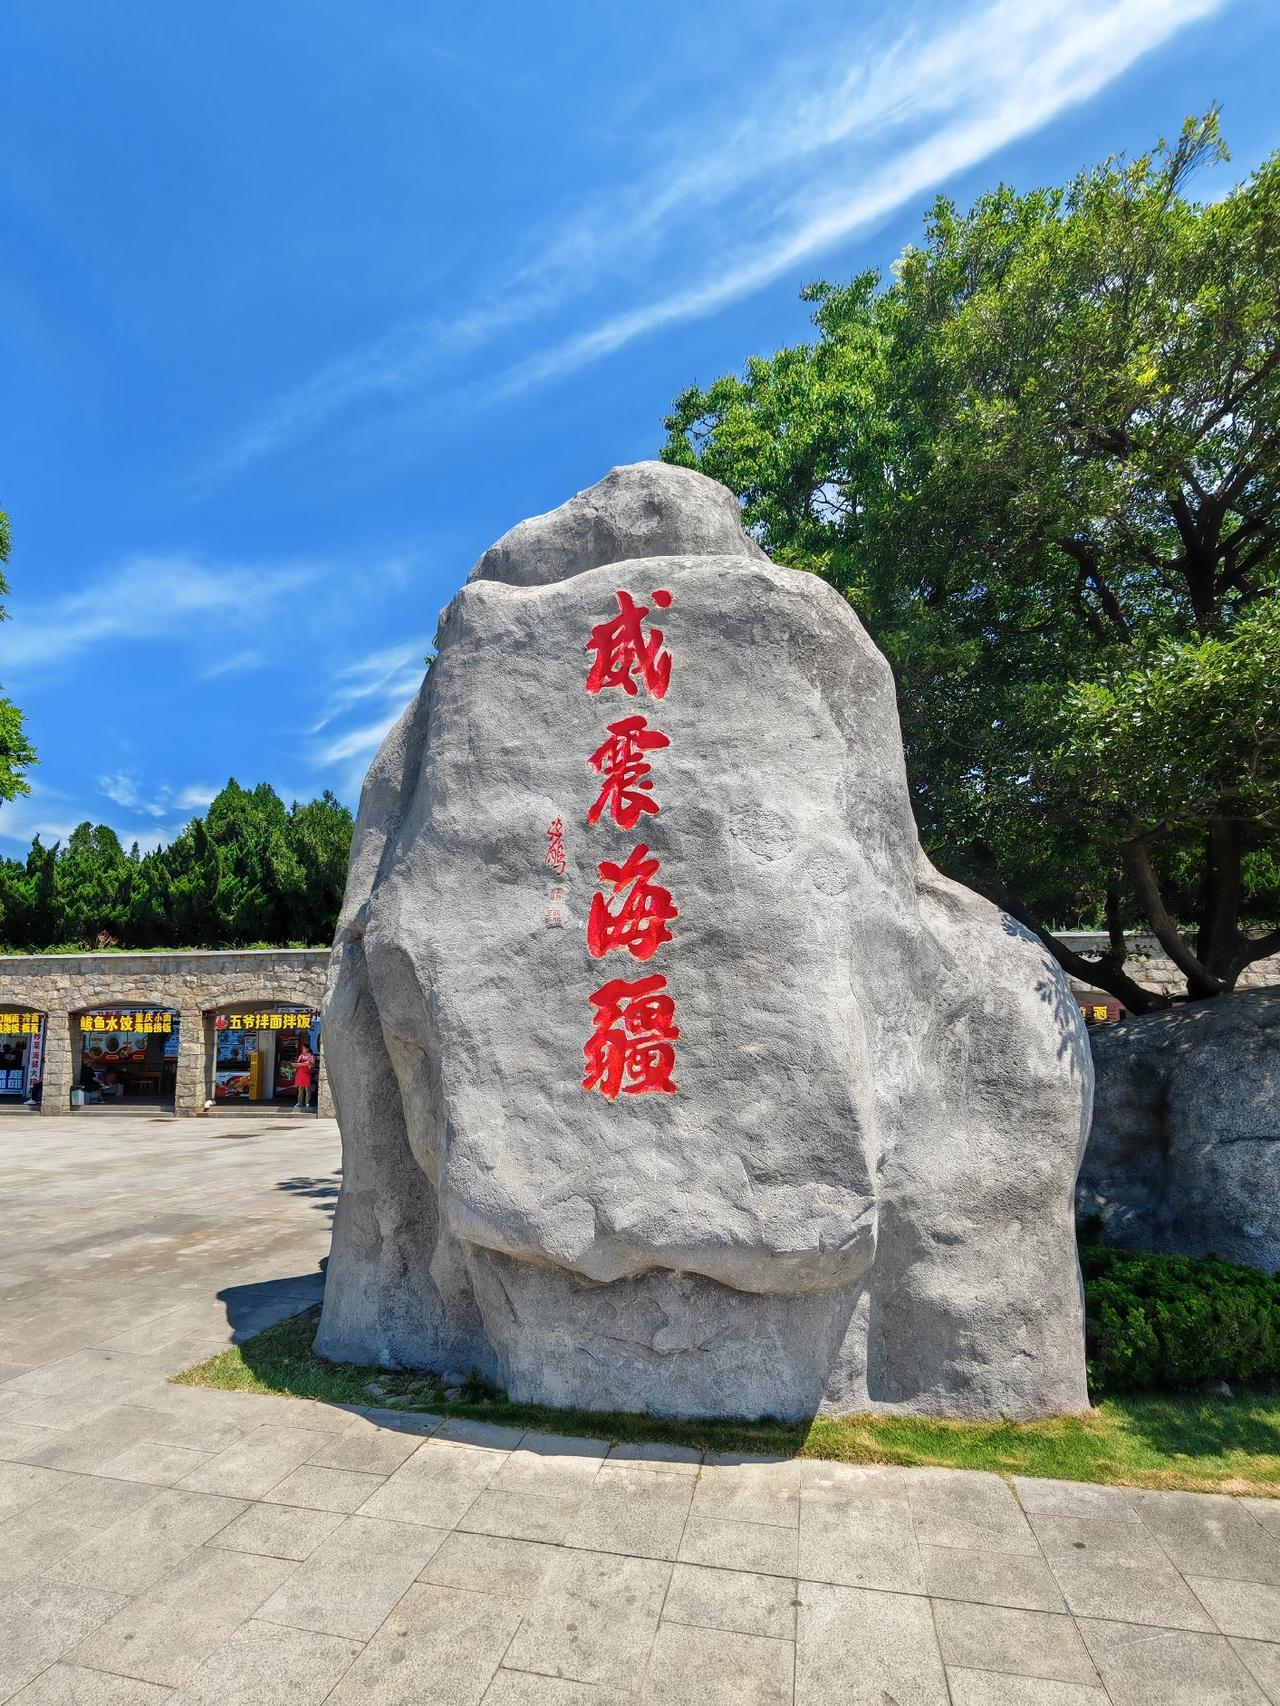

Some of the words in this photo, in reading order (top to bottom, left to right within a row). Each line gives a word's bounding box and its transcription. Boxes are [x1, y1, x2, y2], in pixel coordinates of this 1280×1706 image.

[582, 588, 680, 1100] 威震海疆
[80, 1015, 133, 1032] 鲅鱼水饺
[135, 1012, 172, 1023] 重庆小面
[229, 1013, 311, 1030] 五爷拌面拌饭
[134, 1023, 172, 1033] 海肠捞饭
